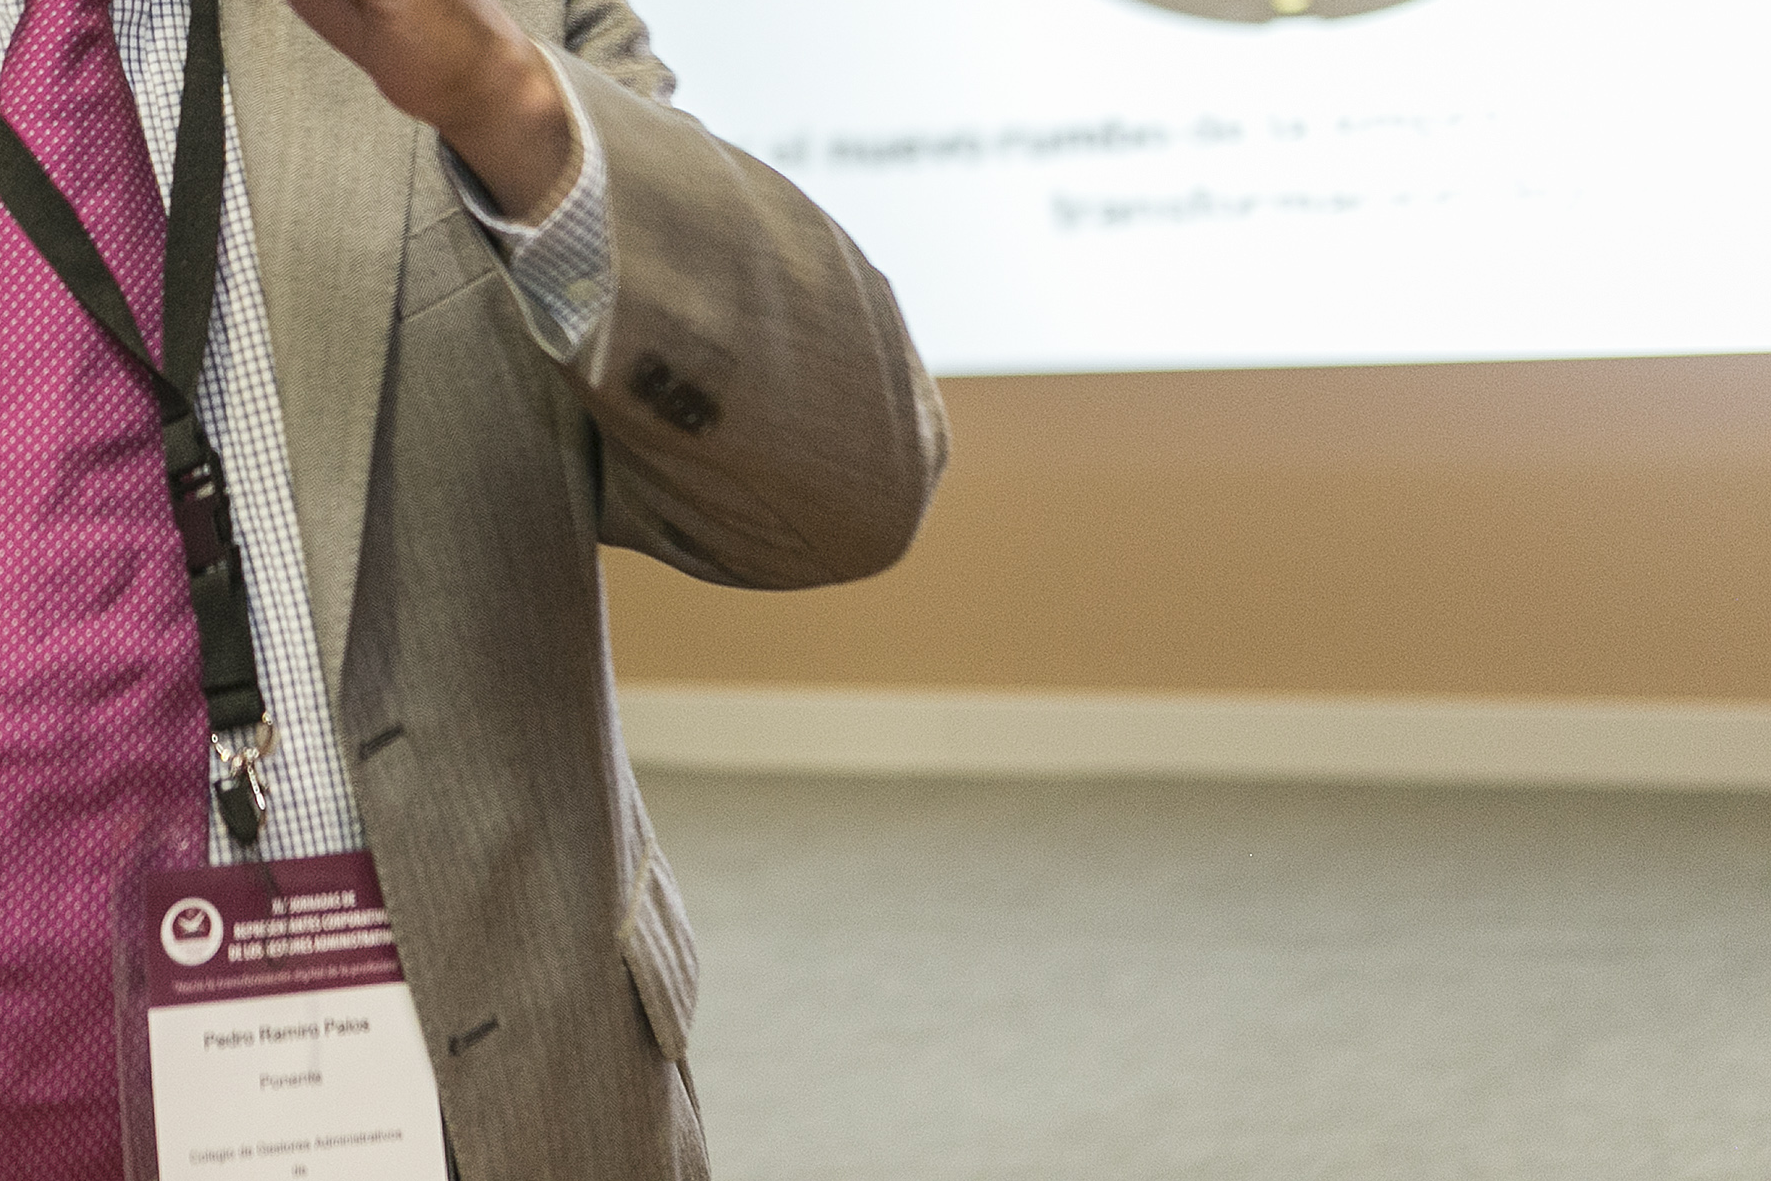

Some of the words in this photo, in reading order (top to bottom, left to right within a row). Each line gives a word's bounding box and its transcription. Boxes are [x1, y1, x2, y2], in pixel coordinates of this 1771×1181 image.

[289, 890, 341, 914] JORNADAS
[341, 889, 356, 908] DE
[228, 942, 242, 962] DE
[203, 1030, 254, 1050] Pedro
[258, 1023, 320, 1045] Ramiro
[259, 1071, 323, 1090] Ponente
